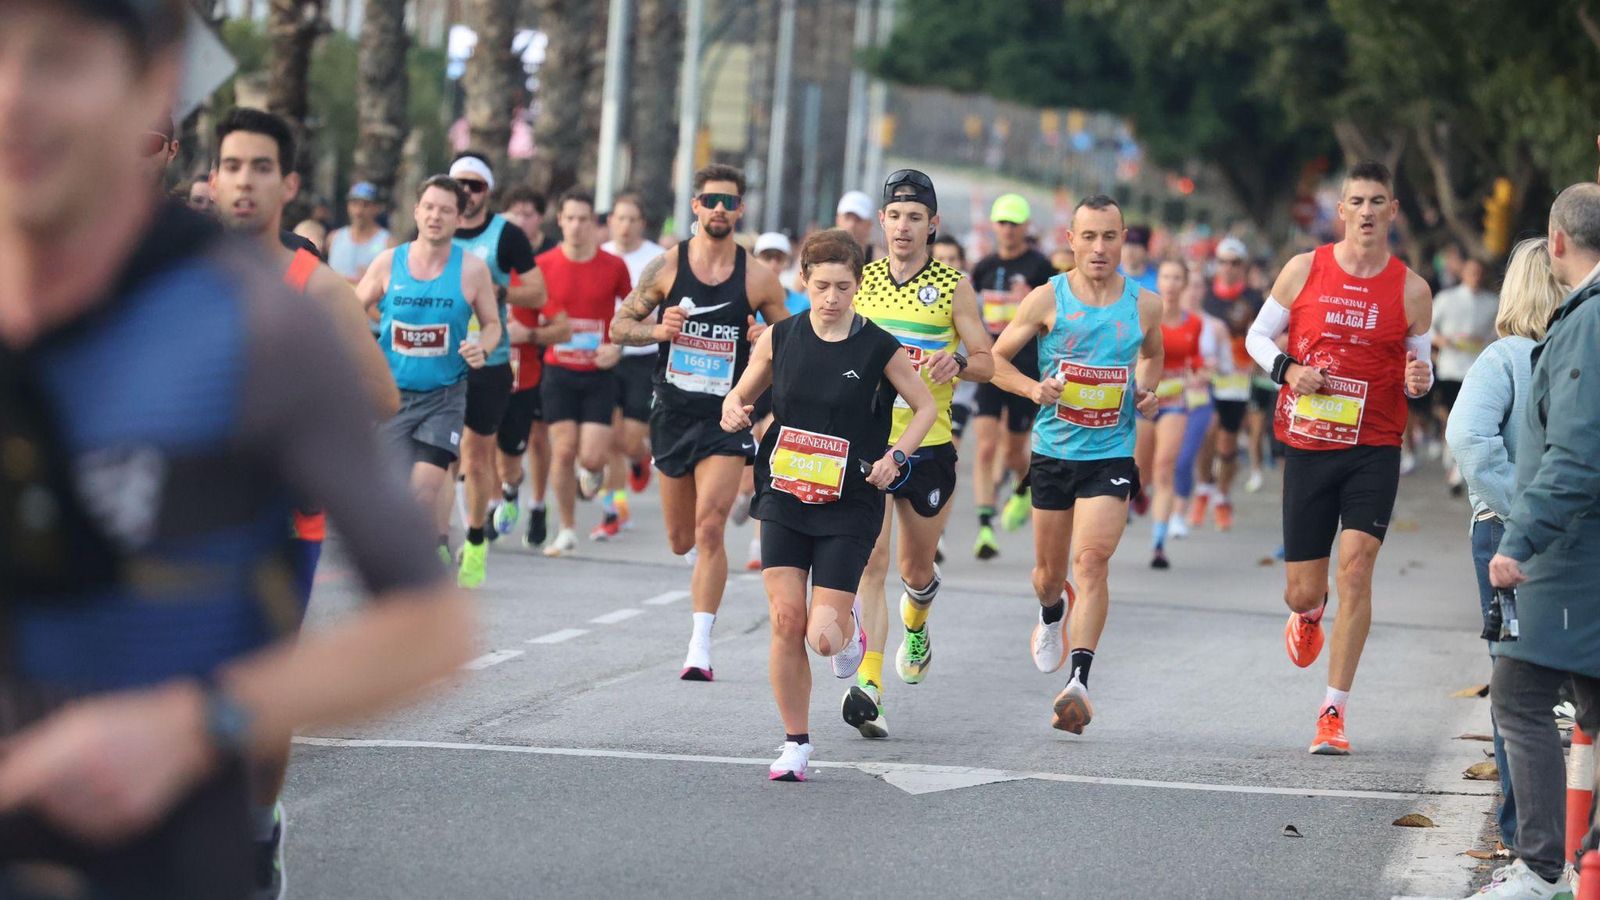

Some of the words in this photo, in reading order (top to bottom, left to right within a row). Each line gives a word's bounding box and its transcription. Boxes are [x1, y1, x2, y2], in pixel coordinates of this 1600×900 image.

[393, 296, 453, 308] SPARTA
[1329, 296, 1367, 309] GENERALI
[1325, 310, 1364, 329] MÁLAGA
[401, 330, 436, 342] 15229
[712, 324, 739, 340] PRE
[689, 339, 731, 351] GENERALI
[684, 354, 720, 370] 16615
[1078, 368, 1123, 379] GENERALI
[1080, 388, 1104, 400] 629
[1325, 379, 1361, 394] NERALI
[1311, 397, 1345, 413] 6204
[795, 434, 843, 452] GENERALI
[790, 455, 823, 472] 2041
